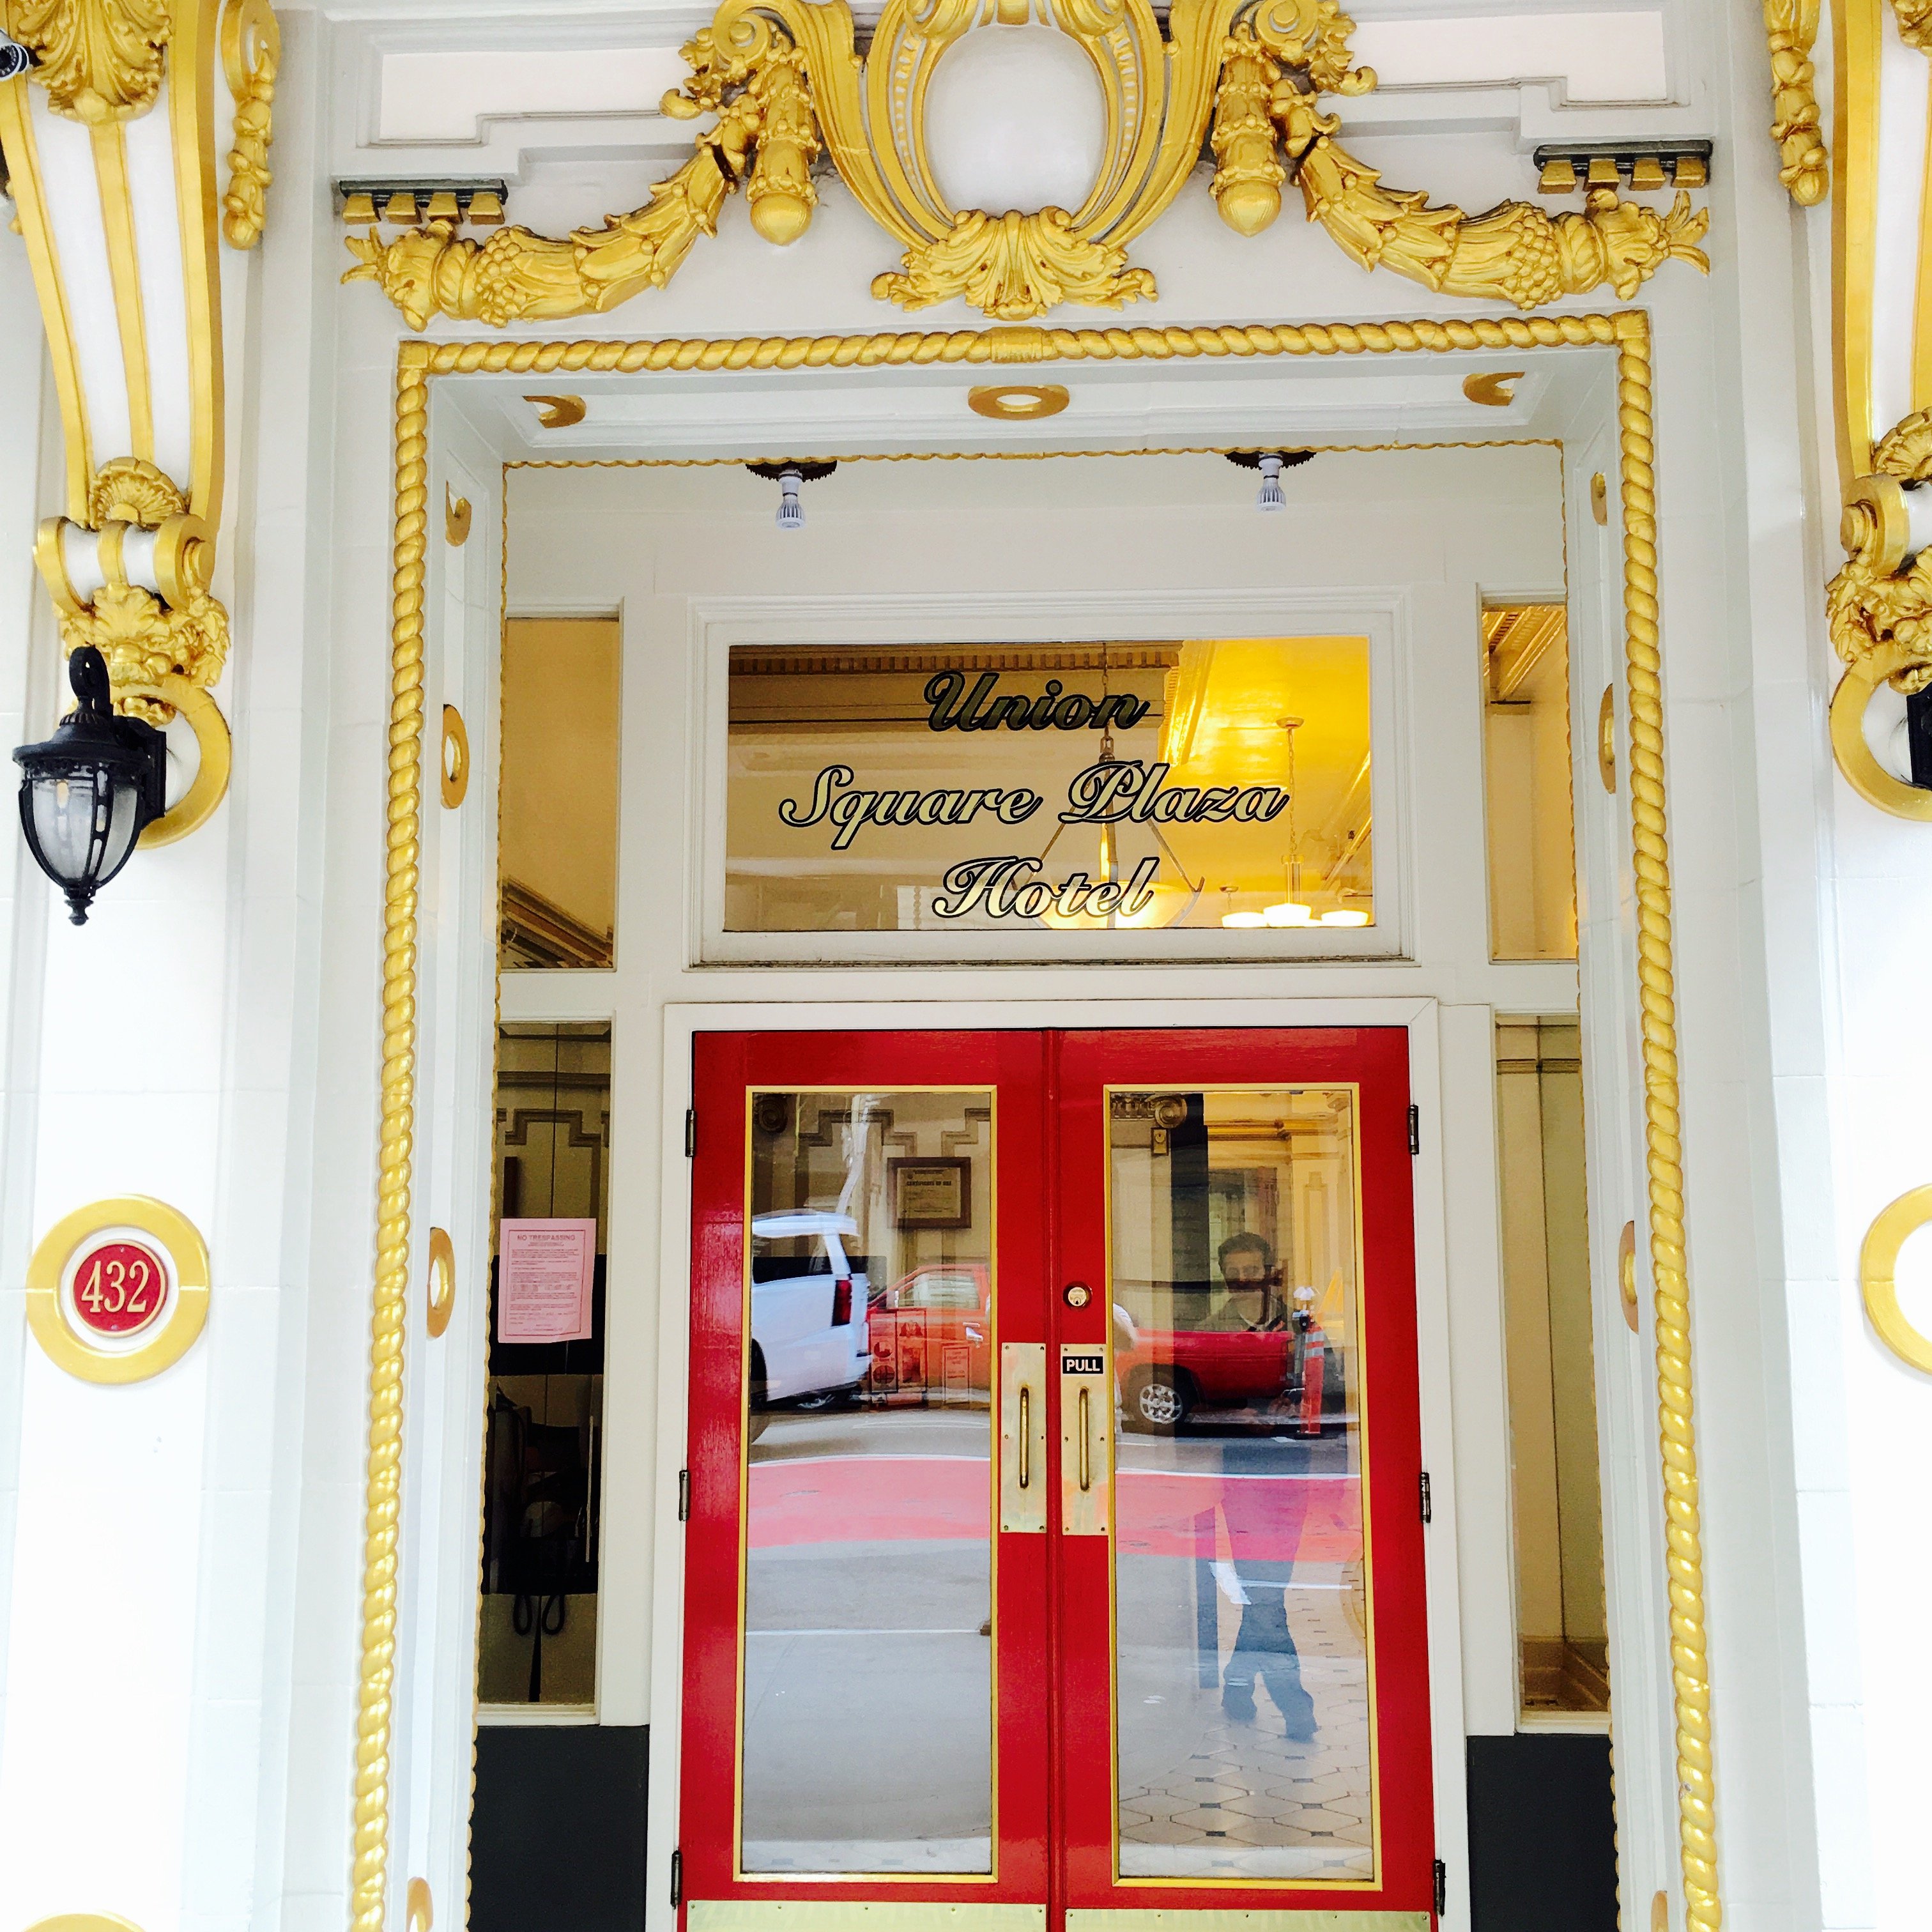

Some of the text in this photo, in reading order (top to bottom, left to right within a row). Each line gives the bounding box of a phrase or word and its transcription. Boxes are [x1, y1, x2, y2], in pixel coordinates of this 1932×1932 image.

[924, 670, 1151, 732] Union
[779, 760, 1290, 850] Square Plaza
[931, 855, 1160, 918] Hotel
[81, 1260, 149, 1312] 432
[1066, 1359, 1100, 1372] PULL
